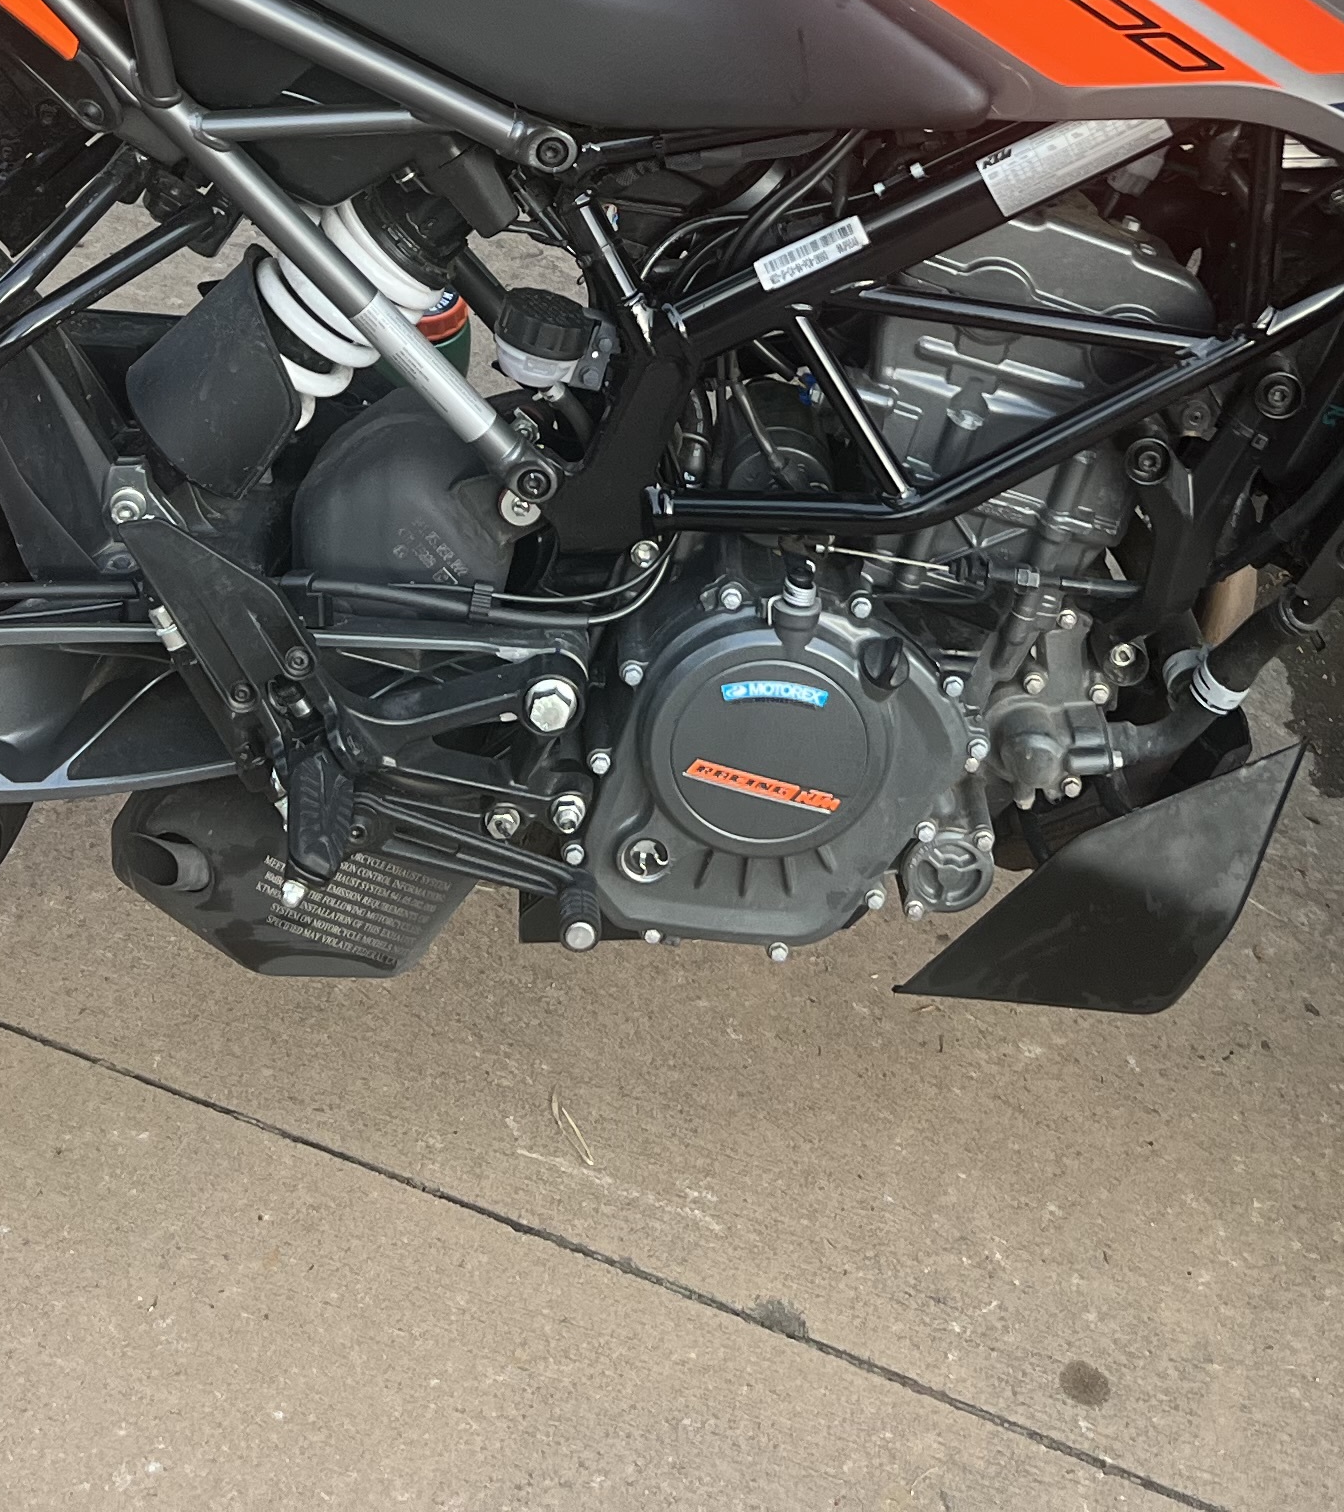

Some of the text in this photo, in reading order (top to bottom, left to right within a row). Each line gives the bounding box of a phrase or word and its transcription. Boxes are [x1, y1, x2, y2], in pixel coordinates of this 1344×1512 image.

[748, 682, 822, 704] MOTOREX
[357, 867, 392, 886] CONTROL
[307, 890, 324, 903] THE
[322, 895, 366, 917] FOLLOWING
[326, 883, 363, 902] EMISSION
[270, 902, 301, 921] SYSTEM
[299, 914, 313, 925] ON
[312, 918, 362, 941] MOTORCYCLE
[299, 900, 353, 925] INSTALLATION
[301, 928, 322, 941] MAY
[321, 934, 353, 952] VIOLATE
